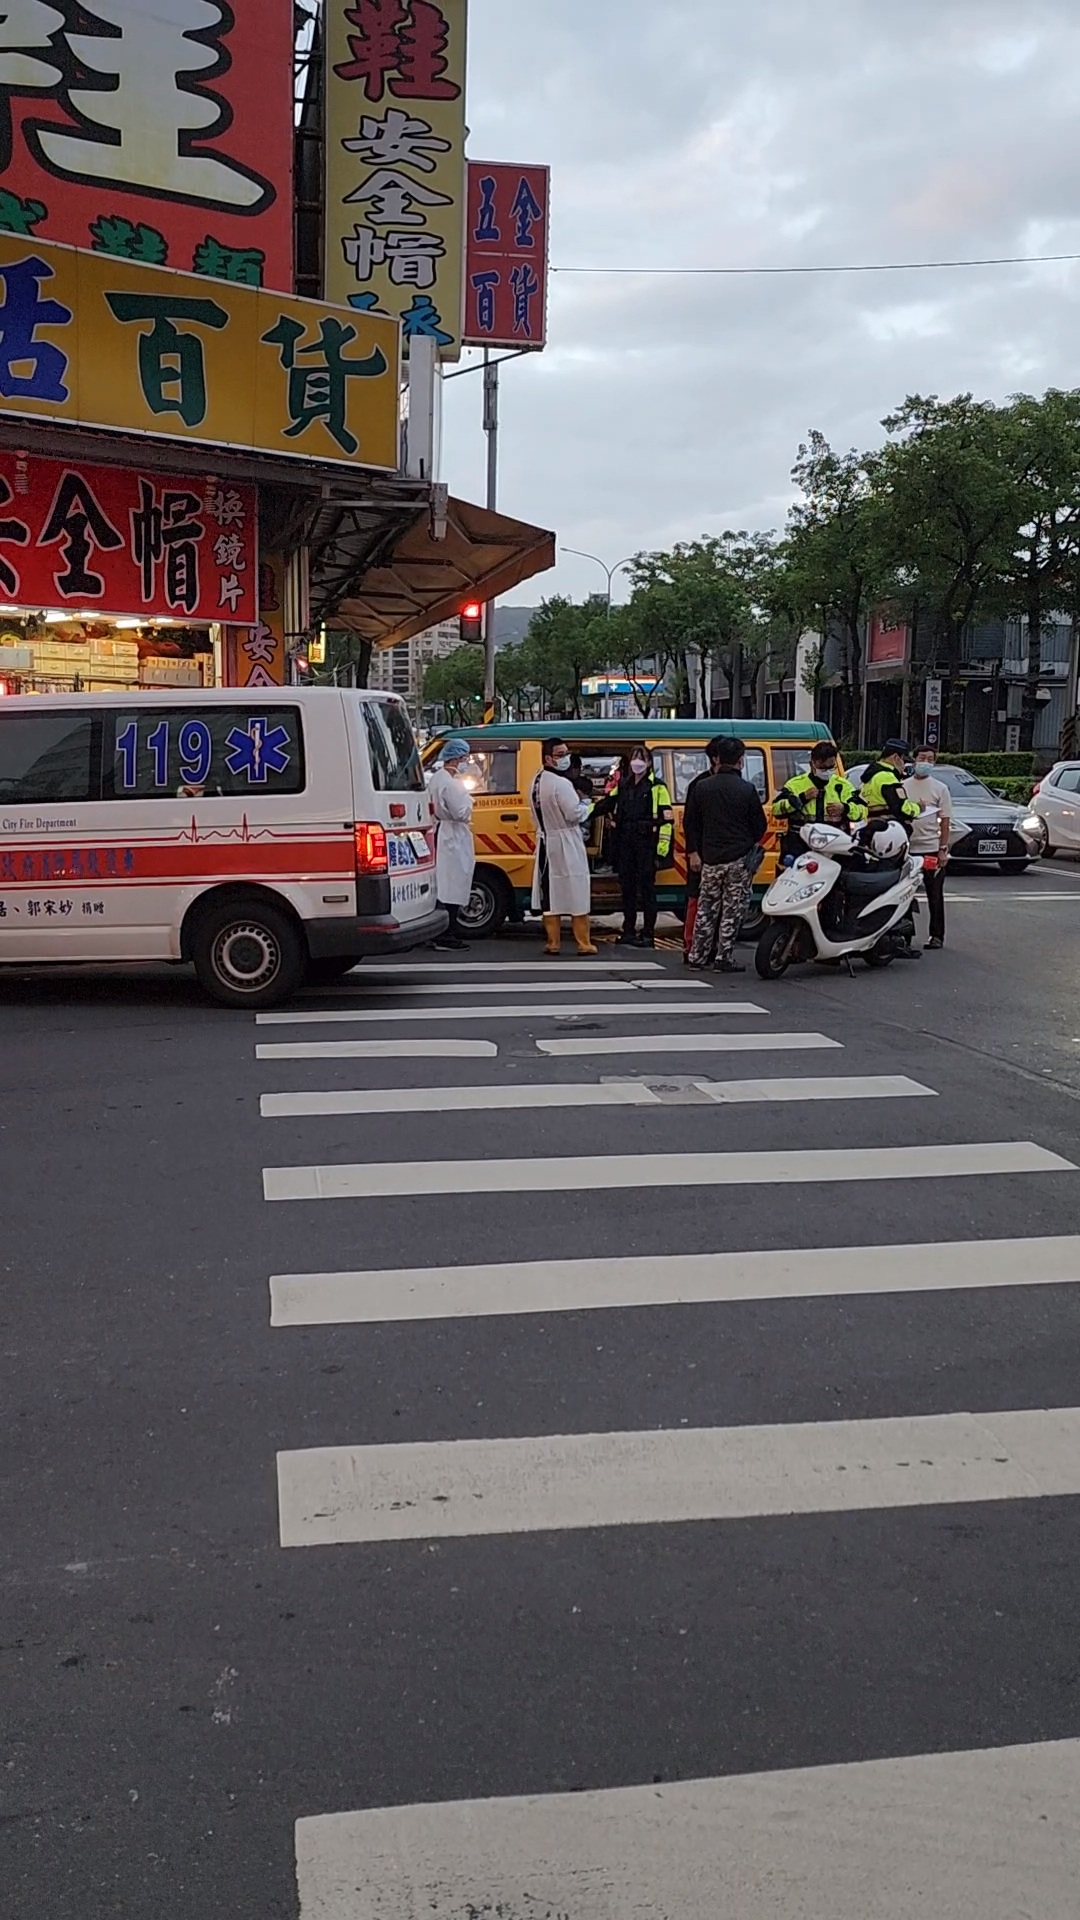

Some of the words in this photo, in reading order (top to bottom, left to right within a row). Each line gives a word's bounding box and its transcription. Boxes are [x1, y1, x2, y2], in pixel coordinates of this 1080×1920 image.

[332, 0, 462, 102] 鞋
[341, 107, 454, 289] 安全帽
[473, 174, 543, 249] 五金
[470, 262, 539, 338] 百貨
[212, 488, 247, 613] 換鏡片
[115, 719, 212, 787] 119
[2, 818, 17, 832] City
[19, 818, 34, 830] Fire
[36, 816, 77, 832] Department
